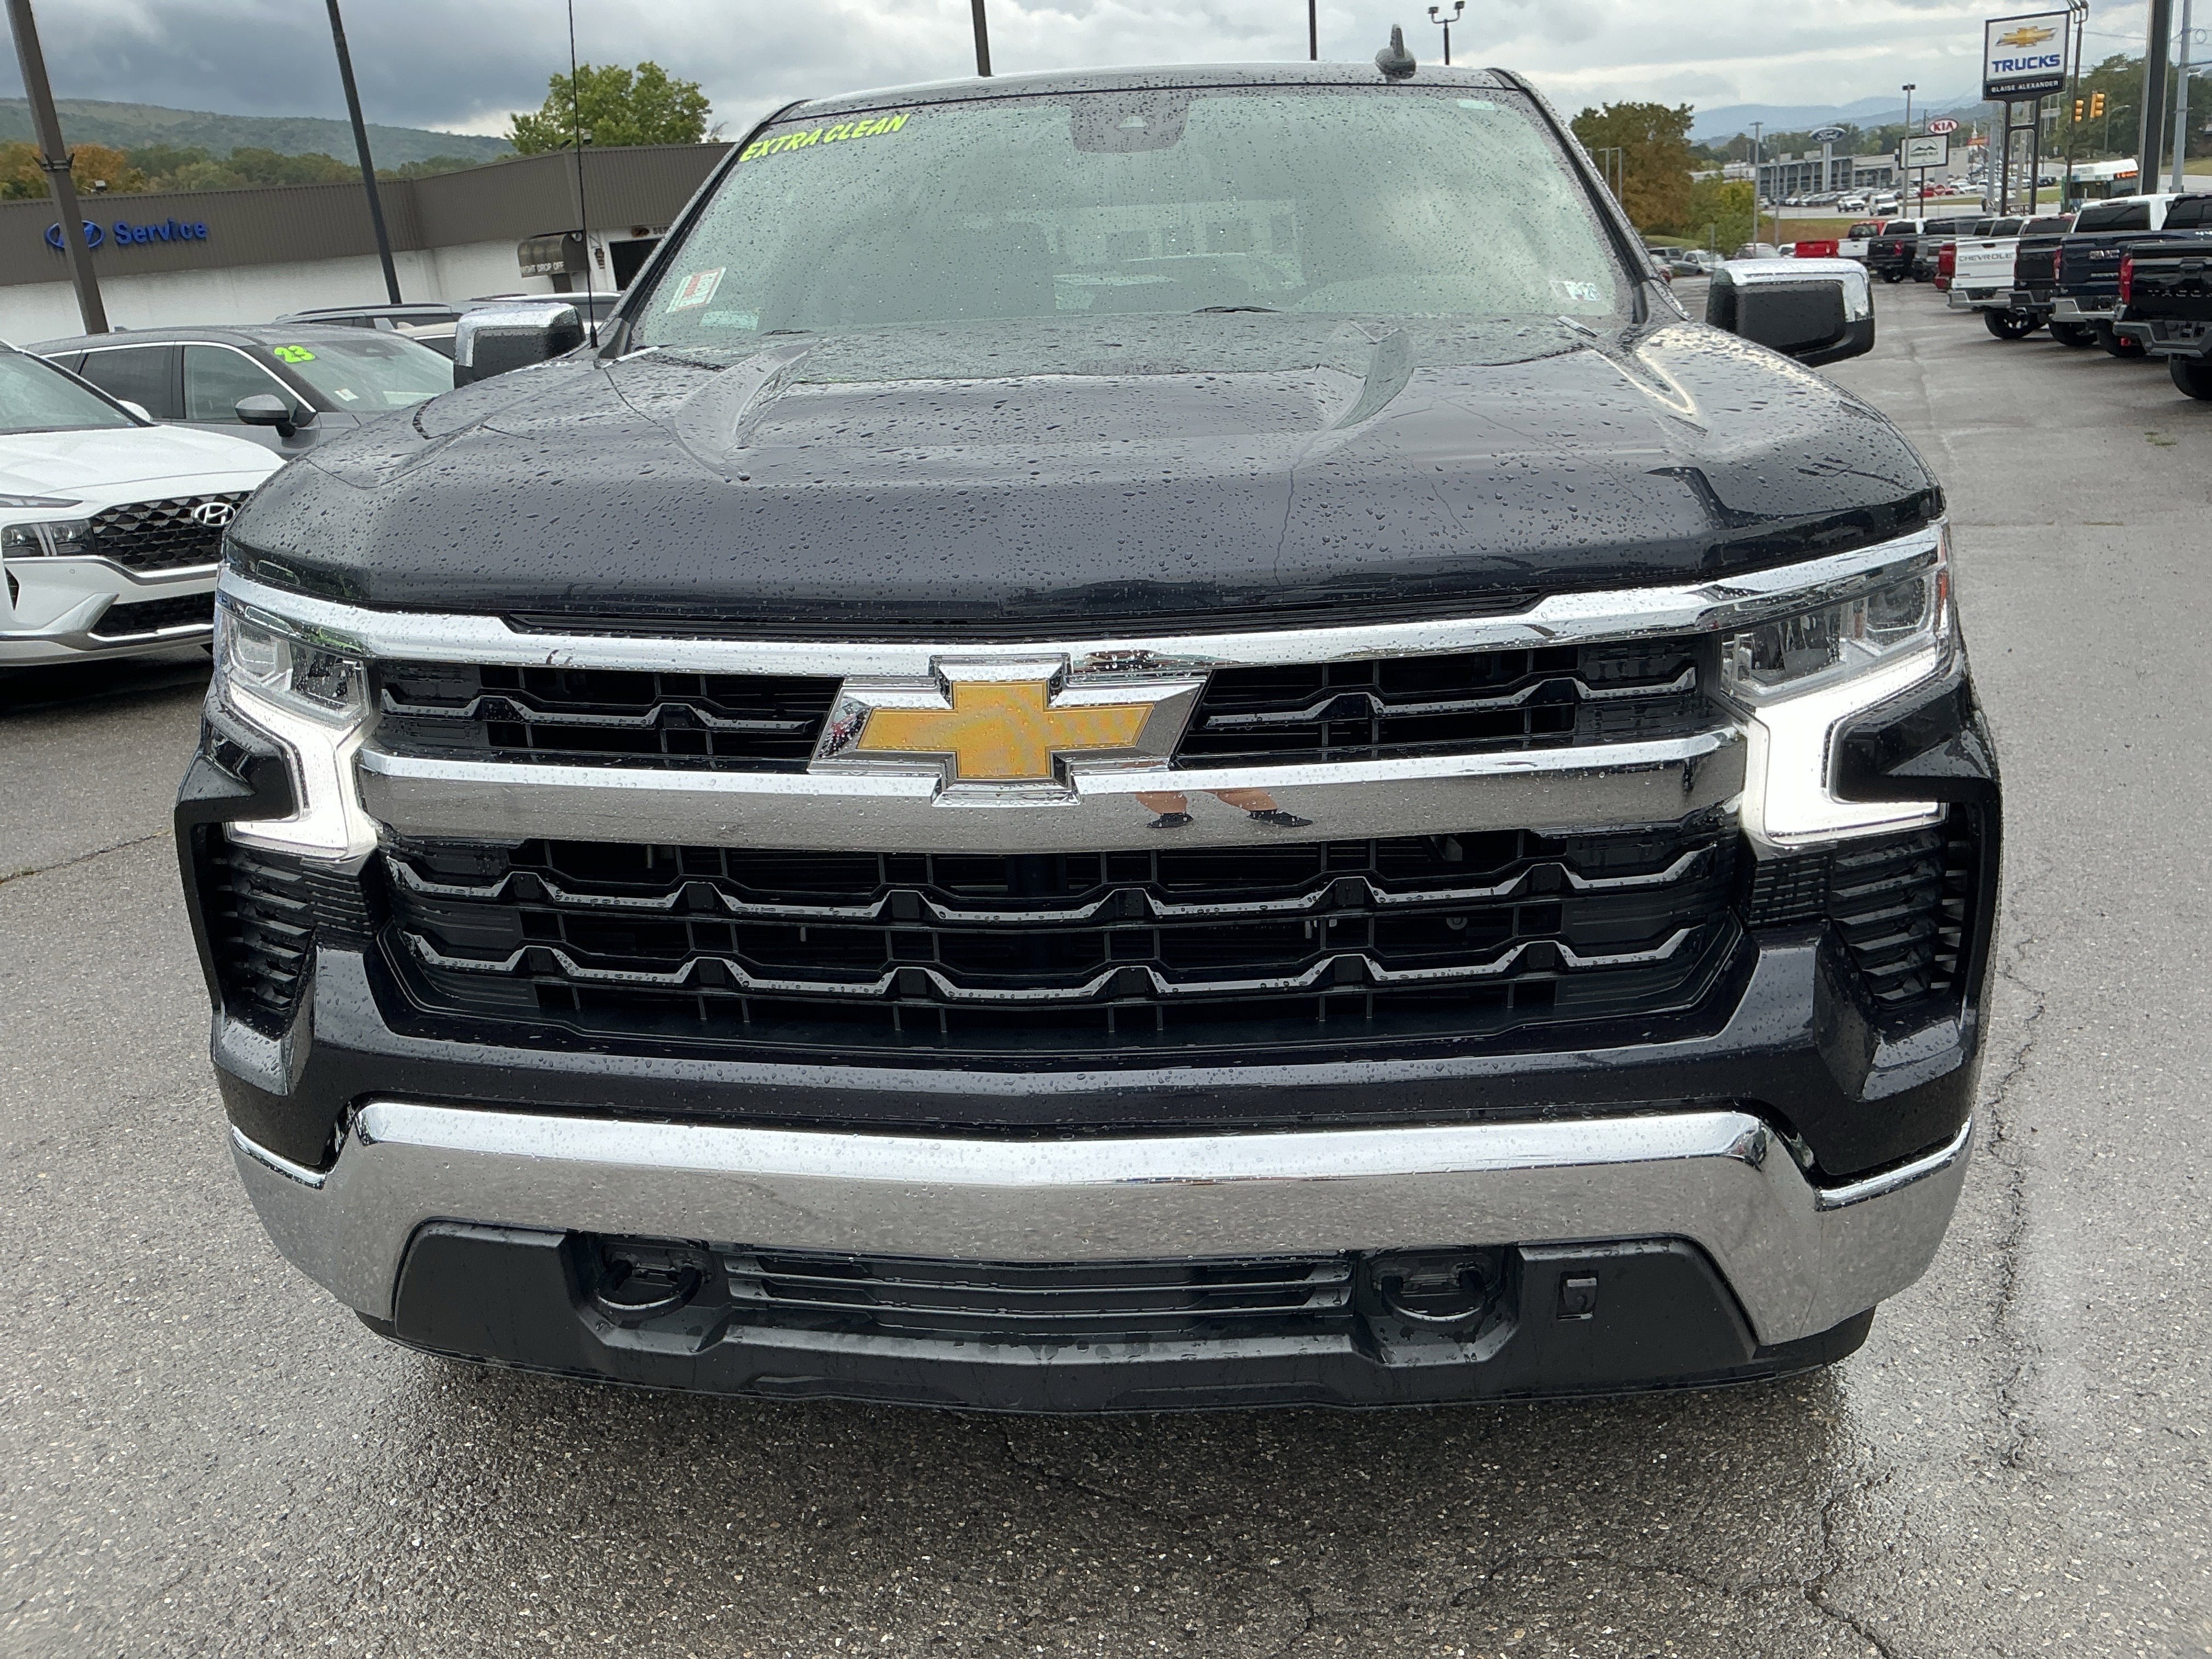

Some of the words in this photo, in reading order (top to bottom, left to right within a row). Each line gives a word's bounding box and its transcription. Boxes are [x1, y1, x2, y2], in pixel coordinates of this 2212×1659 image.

[1992, 54, 2060, 72] TRUCKS
[1991, 84, 2016, 93] BLAISE
[2018, 81, 2058, 89] ALEXANDER
[1934, 121, 1954, 131] KIA
[740, 128, 823, 162] EXTRA
[823, 114, 910, 143] CLEAN
[114, 217, 207, 245] Service
[1959, 252, 2012, 261] CHEVROLE
[274, 345, 315, 363] 23
